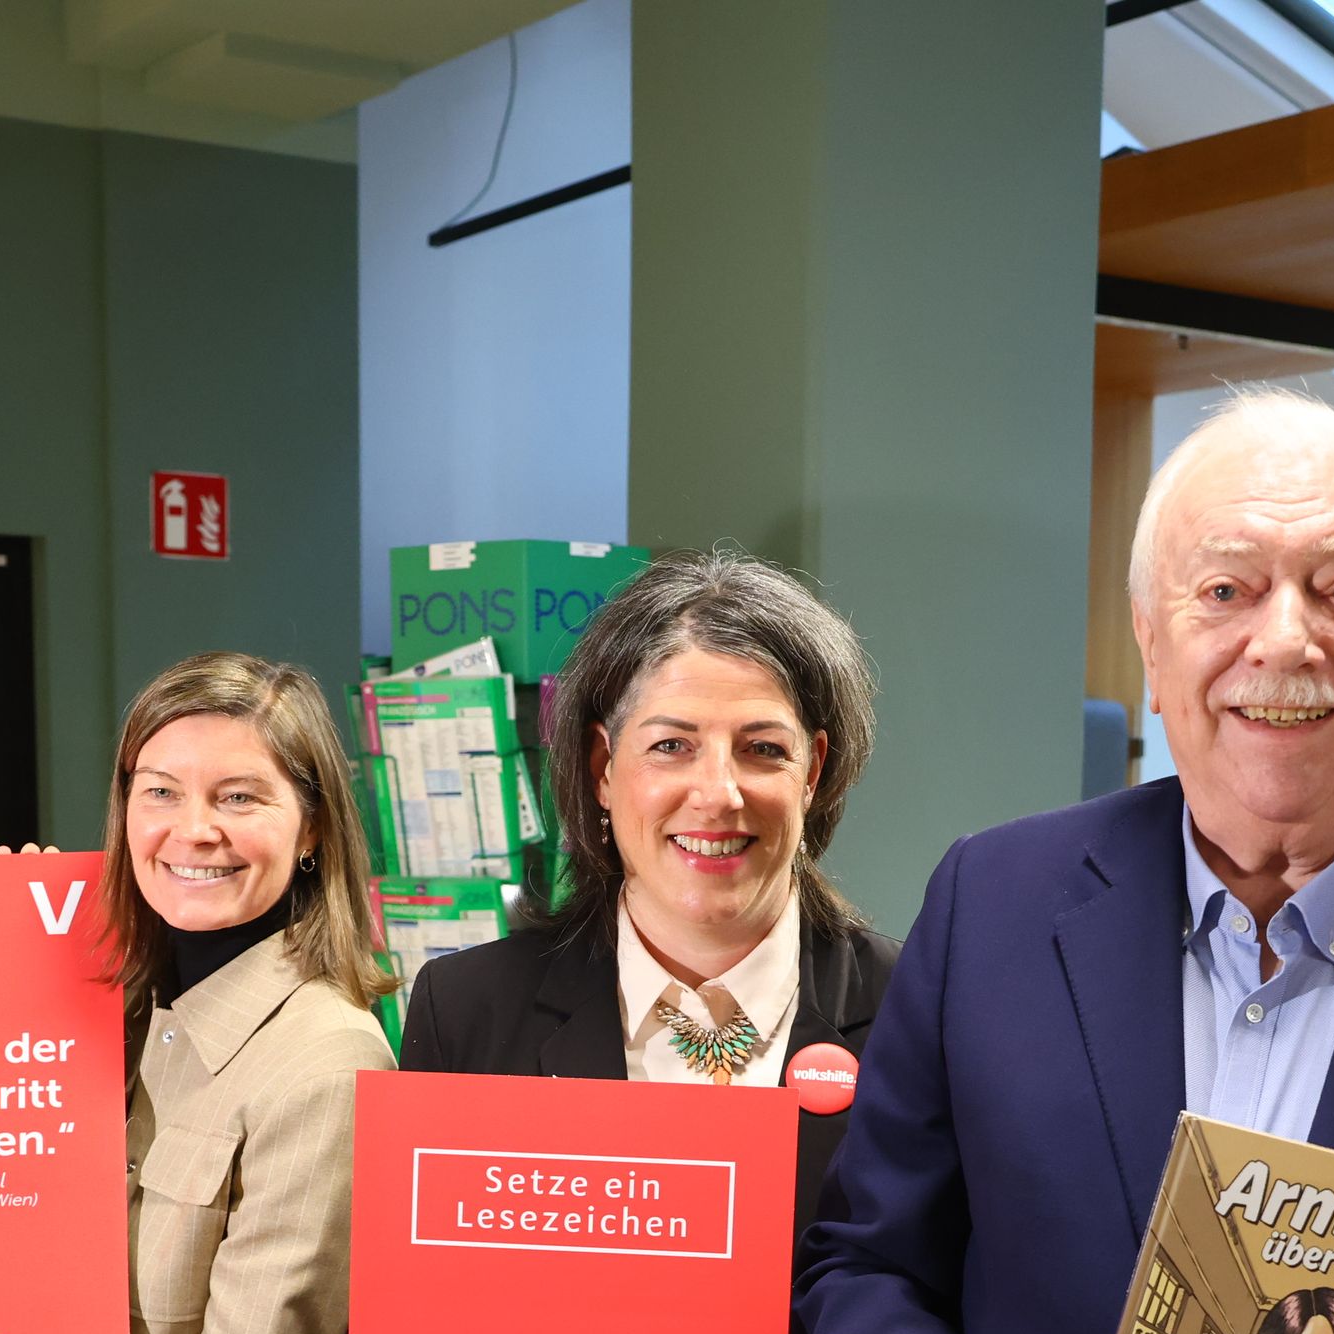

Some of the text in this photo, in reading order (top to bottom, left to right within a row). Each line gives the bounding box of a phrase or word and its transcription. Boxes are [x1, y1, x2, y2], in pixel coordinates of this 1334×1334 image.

[400, 588, 516, 636] PONS
[28, 881, 86, 935] V
[5, 1032, 74, 1062] der
[794, 1068, 856, 1084] volkshilfe.
[484, 1165, 661, 1200] Setze ein
[456, 1201, 688, 1238] Lesezeichen
